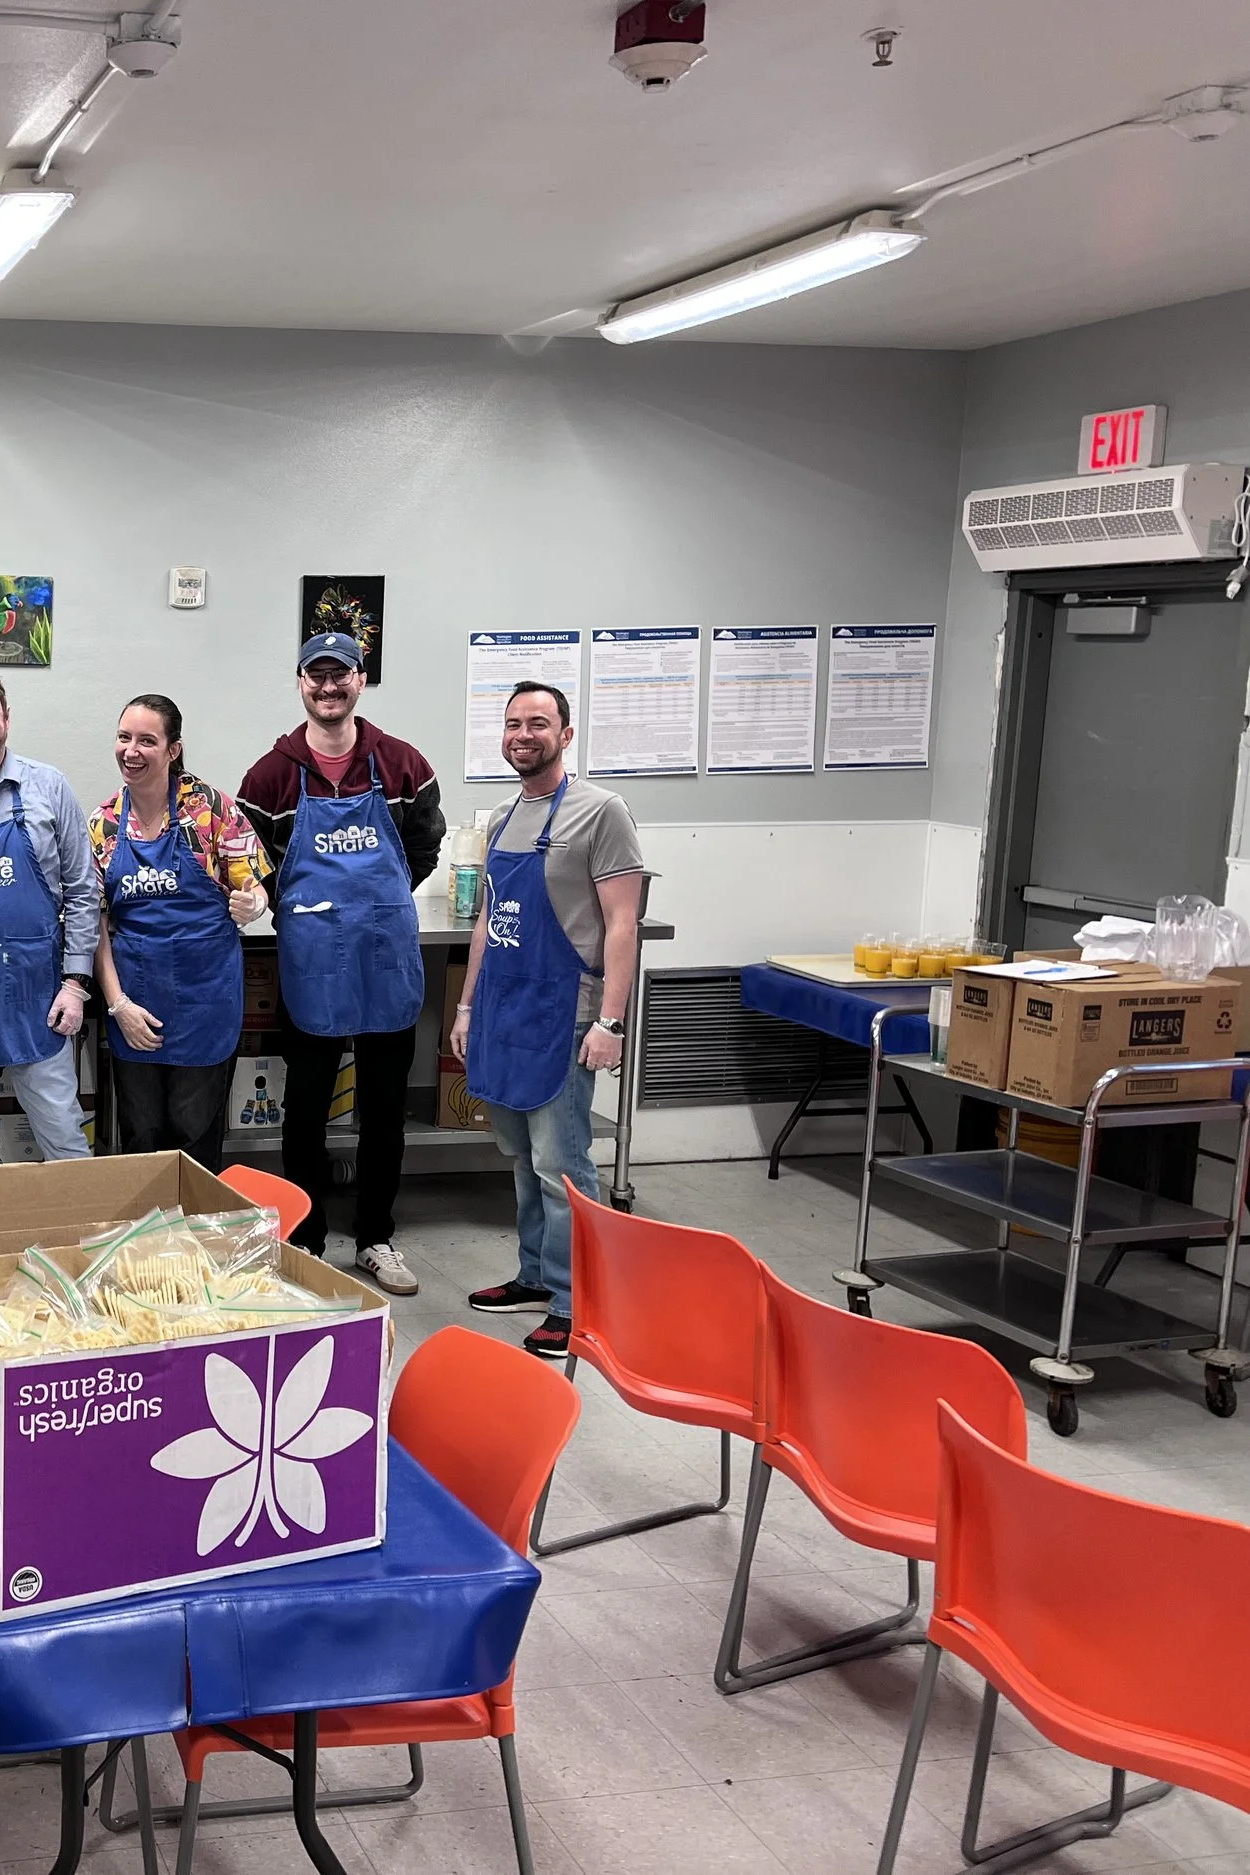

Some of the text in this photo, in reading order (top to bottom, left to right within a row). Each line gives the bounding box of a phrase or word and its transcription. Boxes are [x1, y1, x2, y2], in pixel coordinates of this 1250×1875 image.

[1090, 410, 1145, 469] EXIT
[314, 833, 379, 853] Share
[122, 874, 178, 894] Share
[498, 901, 521, 914] Share
[1118, 998, 1139, 1007] STORE
[1149, 997, 1166, 1005] COOL
[1167, 996, 1180, 1004] DRY
[1182, 996, 1202, 1004] PLACE
[1132, 1018, 1182, 1038] LANGERS
[1118, 1046, 1190, 1058] BOTTLED ORANGE JUICE
[20, 1368, 144, 1408] organics
[19, 1394, 163, 1442] superfresh
[18, 1585, 34, 1593] USDA
